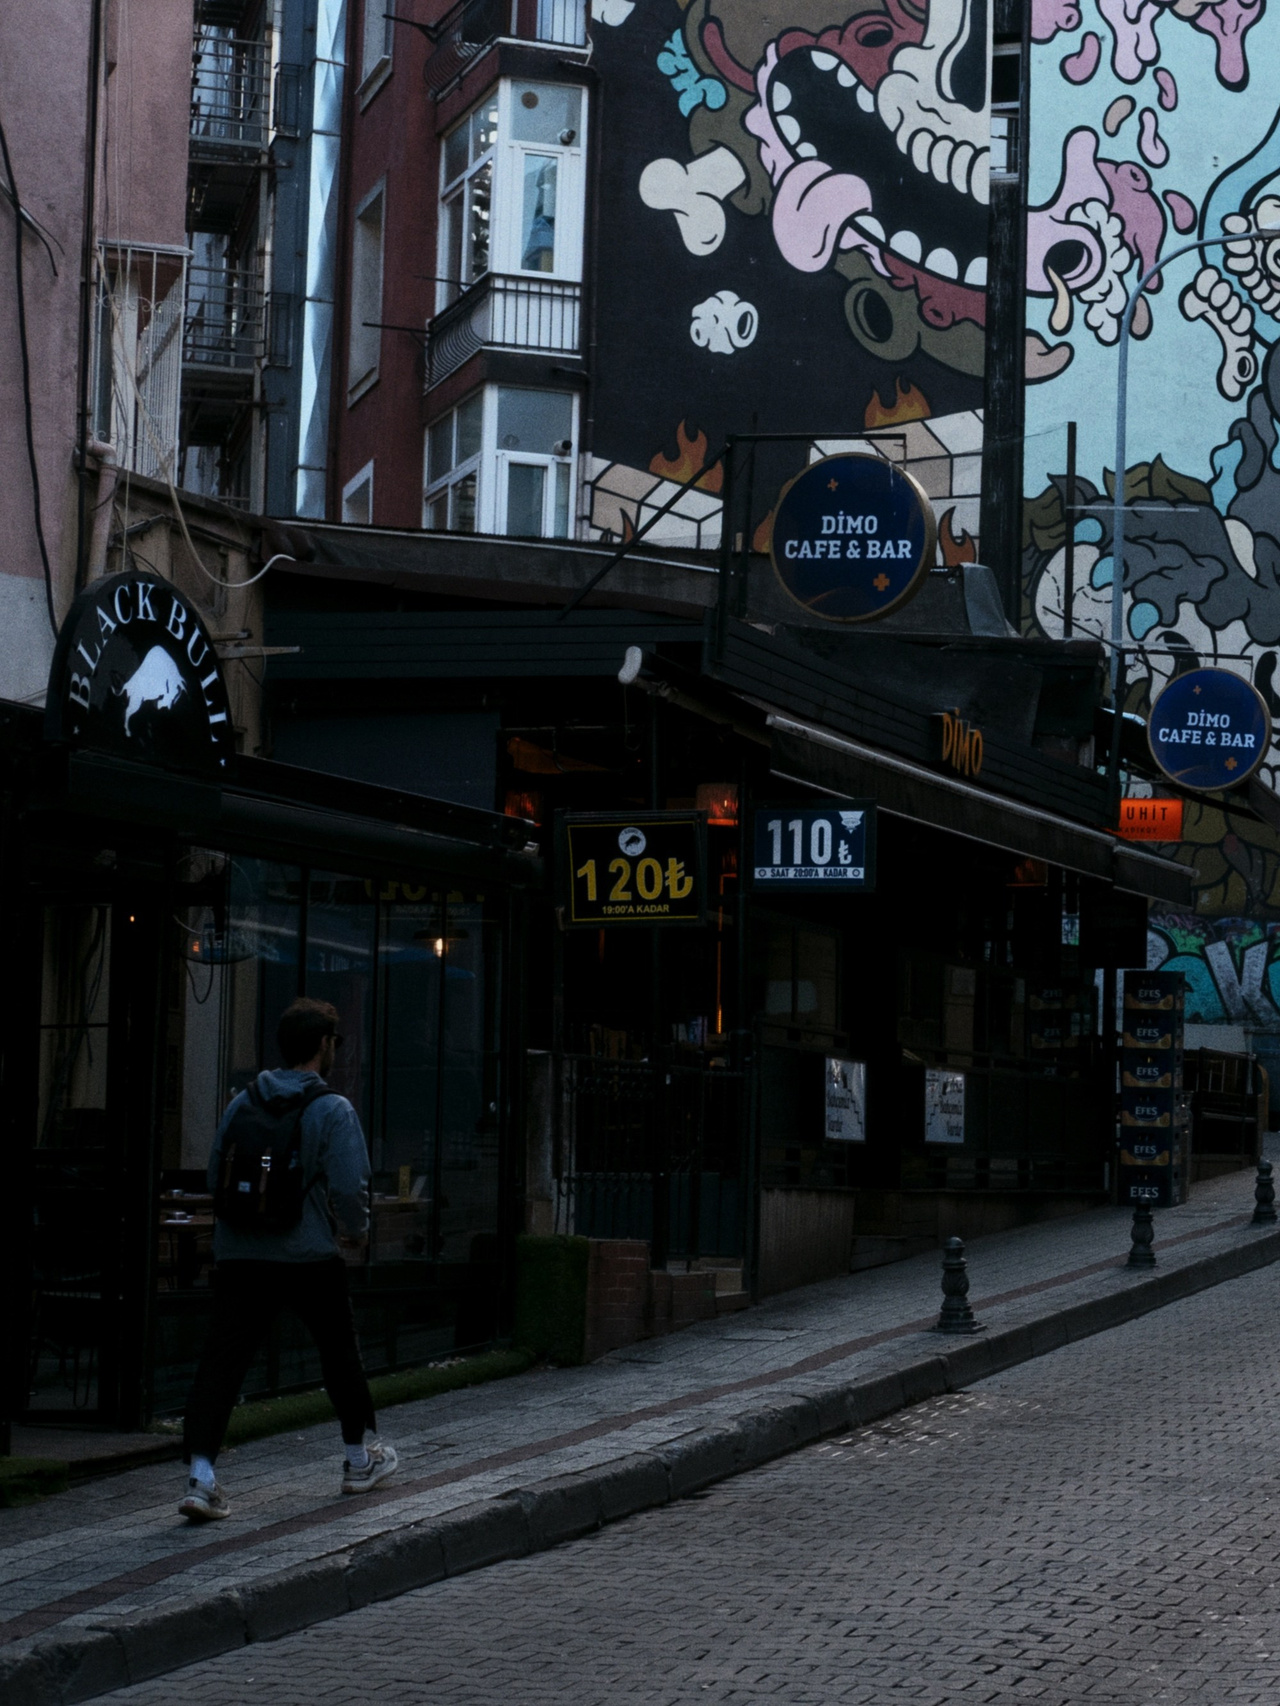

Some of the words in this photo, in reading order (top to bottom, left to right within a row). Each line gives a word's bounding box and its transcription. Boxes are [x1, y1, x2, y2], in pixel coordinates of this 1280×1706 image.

[821, 510, 878, 534] DİMO
[784, 540, 841, 559] CAFE
[846, 540, 861, 559] &
[866, 540, 912, 559] BAR
[69, 581, 157, 714] BLACK
[165, 595, 229, 743] BULL
[1186, 709, 1231, 728] DİMO
[941, 706, 983, 777] DİMO
[1158, 728, 1202, 745] CAFE
[1205, 731, 1217, 745] &
[1220, 732, 1255, 748] BAR
[771, 868, 789, 877] SAAT
[823, 868, 848, 877] KADAR
[577, 857, 694, 901] 120₺
[602, 904, 635, 914] 19:00'A
[636, 904, 670, 913] KADAR
[1138, 989, 1161, 998] EFES
[1136, 1028, 1159, 1037] EFES
[1136, 1067, 1159, 1076] EFES
[1135, 1106, 1158, 1115] EFES
[1134, 1145, 1157, 1154] EFES
[1130, 1187, 1159, 1199] EFES
